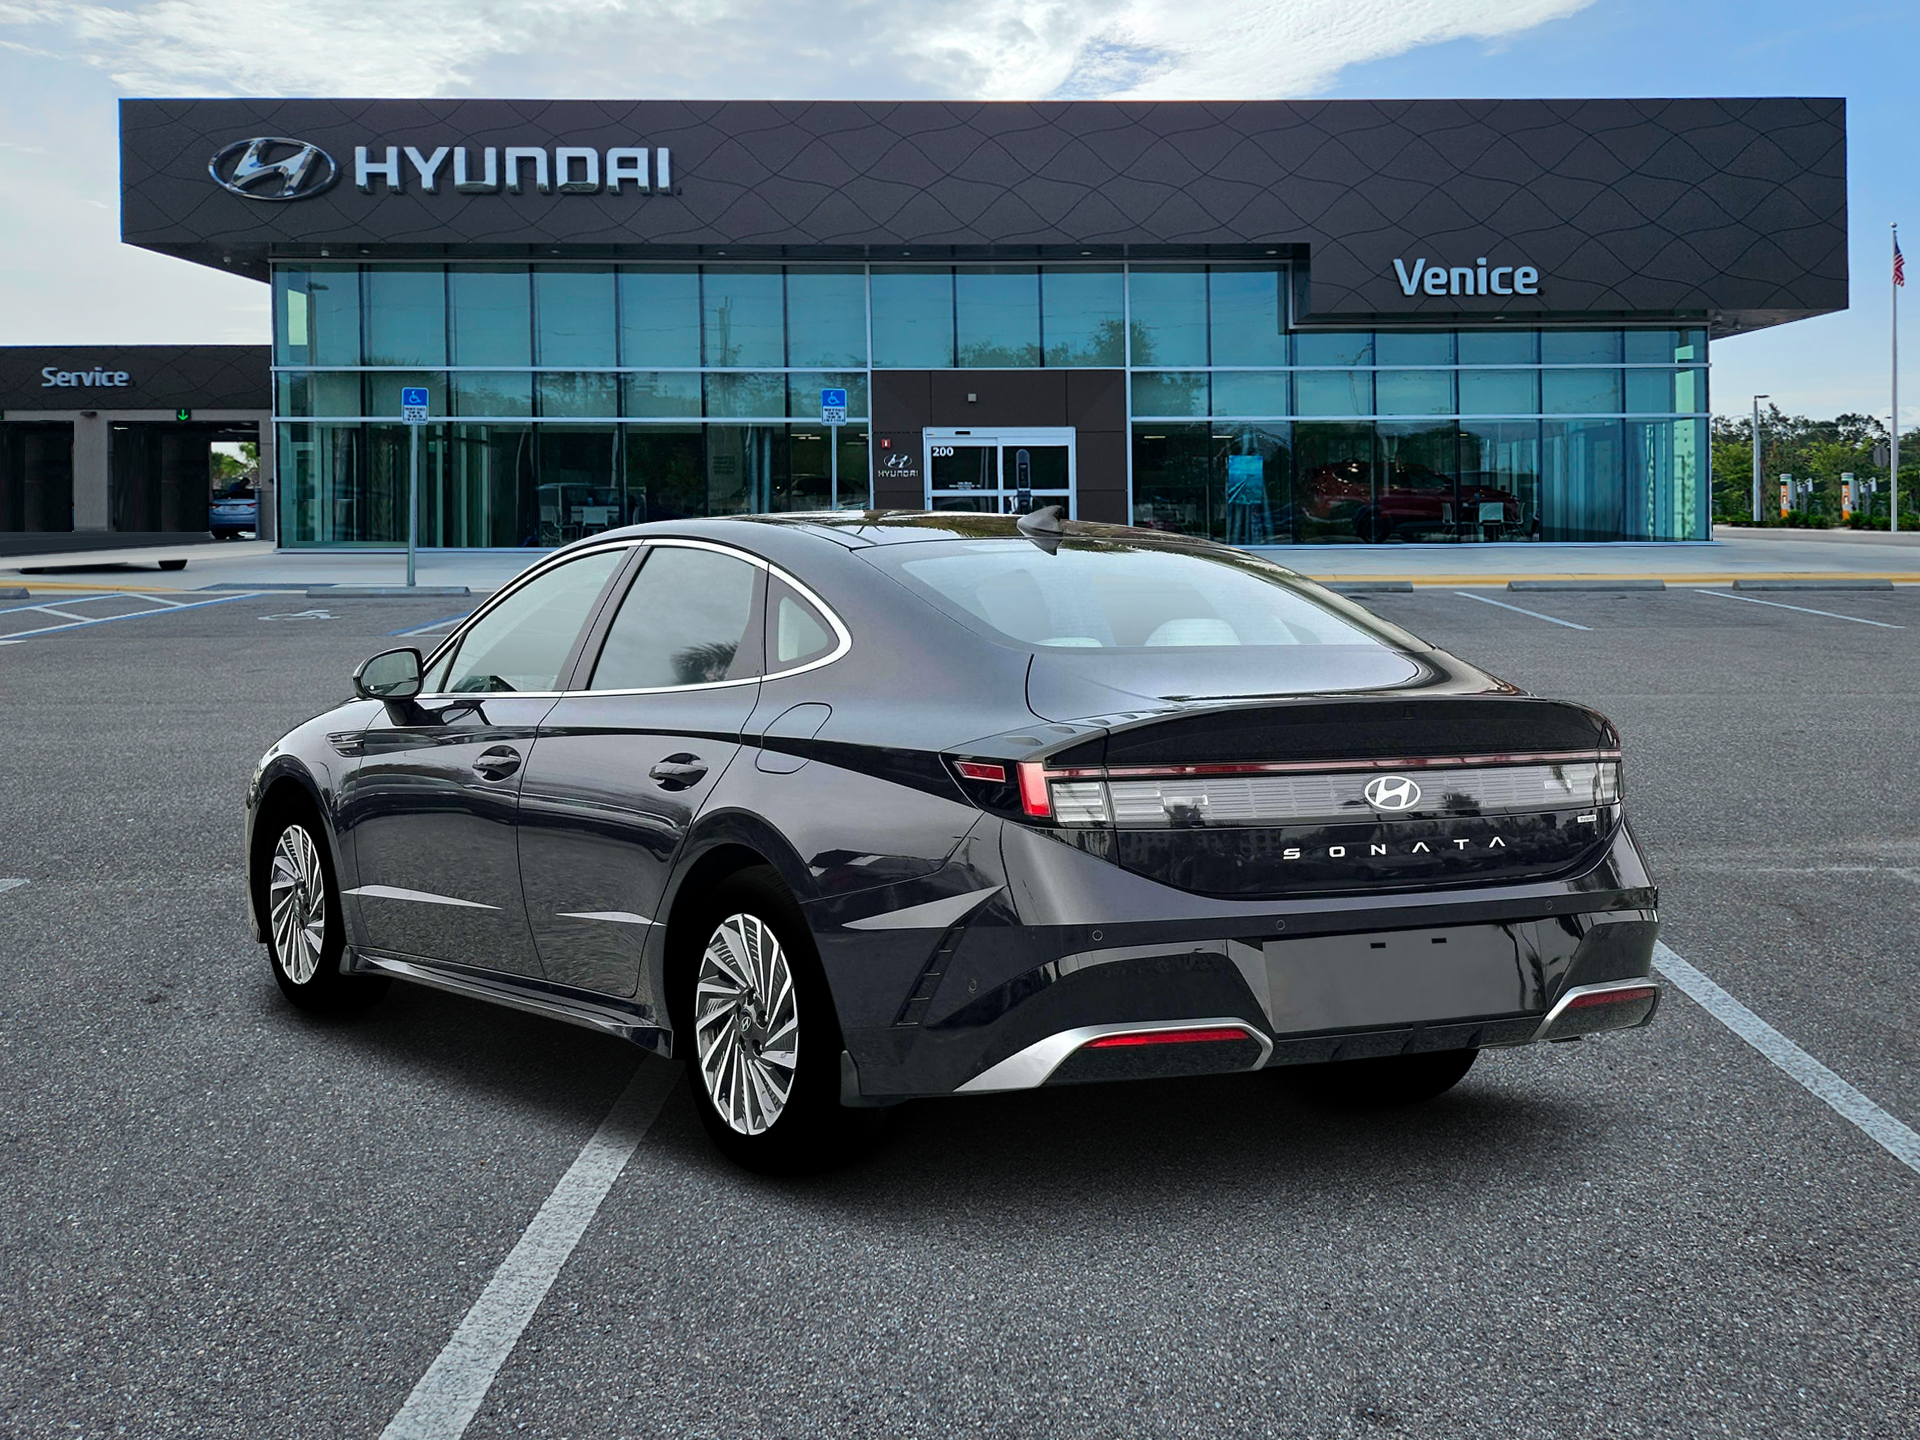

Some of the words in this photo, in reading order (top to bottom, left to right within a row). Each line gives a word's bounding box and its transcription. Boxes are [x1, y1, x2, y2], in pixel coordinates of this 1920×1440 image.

[354, 146, 672, 194] HYUNDAI
[1393, 257, 1538, 296] Venice
[41, 366, 130, 387] Service
[932, 447, 954, 457] 200
[1283, 836, 1506, 860] SONATA
